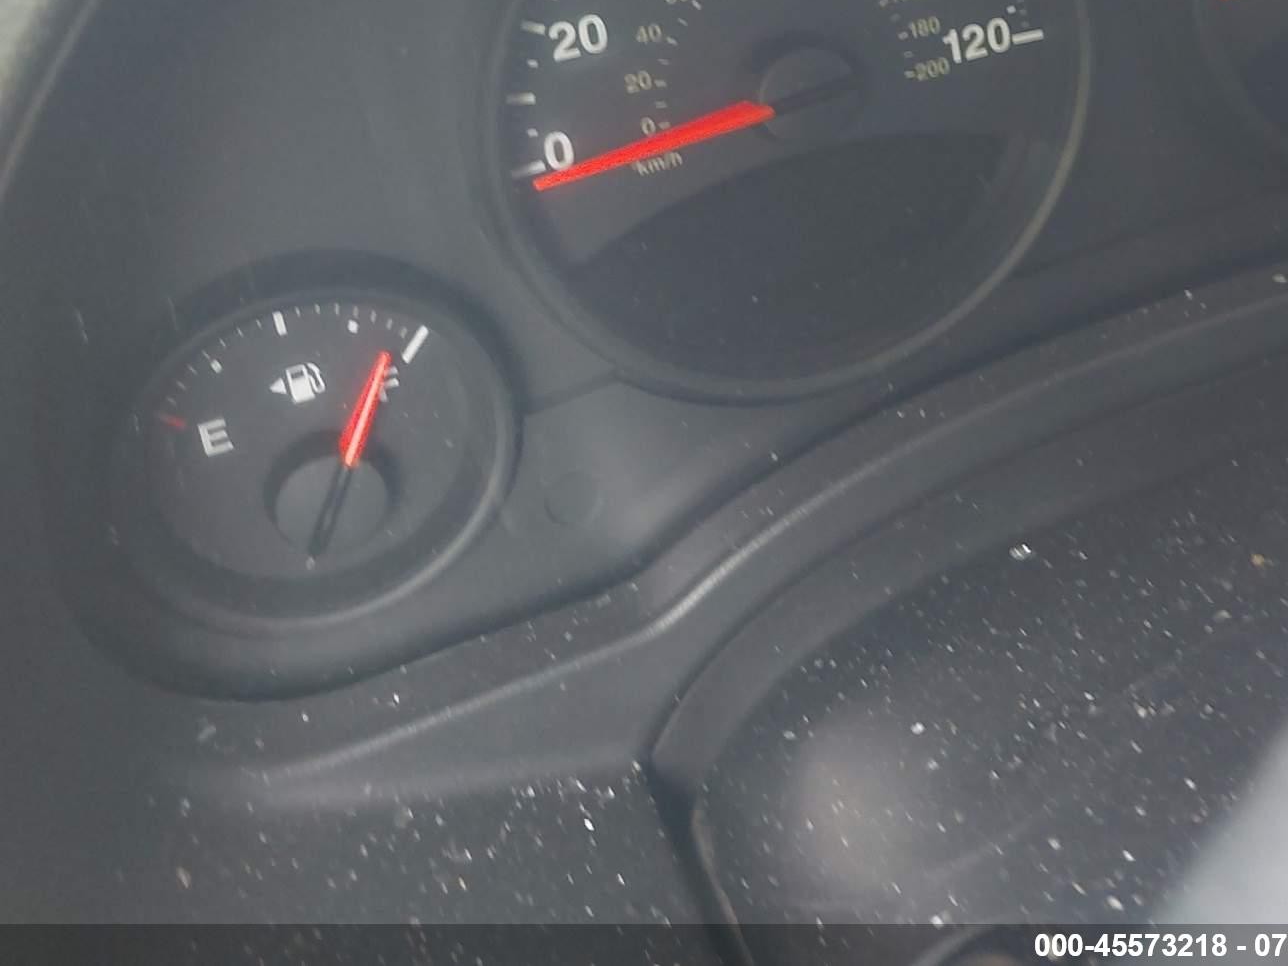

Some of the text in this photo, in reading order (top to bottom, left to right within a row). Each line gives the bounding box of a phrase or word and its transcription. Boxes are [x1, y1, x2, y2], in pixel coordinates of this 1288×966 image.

[549, 14, 608, 62] 20
[635, 24, 662, 44] 40
[909, 16, 941, 38] 180
[943, 17, 1012, 64] 120
[915, 56, 950, 81] 200
[624, 70, 652, 94] 20
[640, 116, 656, 136] 0
[544, 131, 575, 169] 0
[198, 418, 234, 457] E
